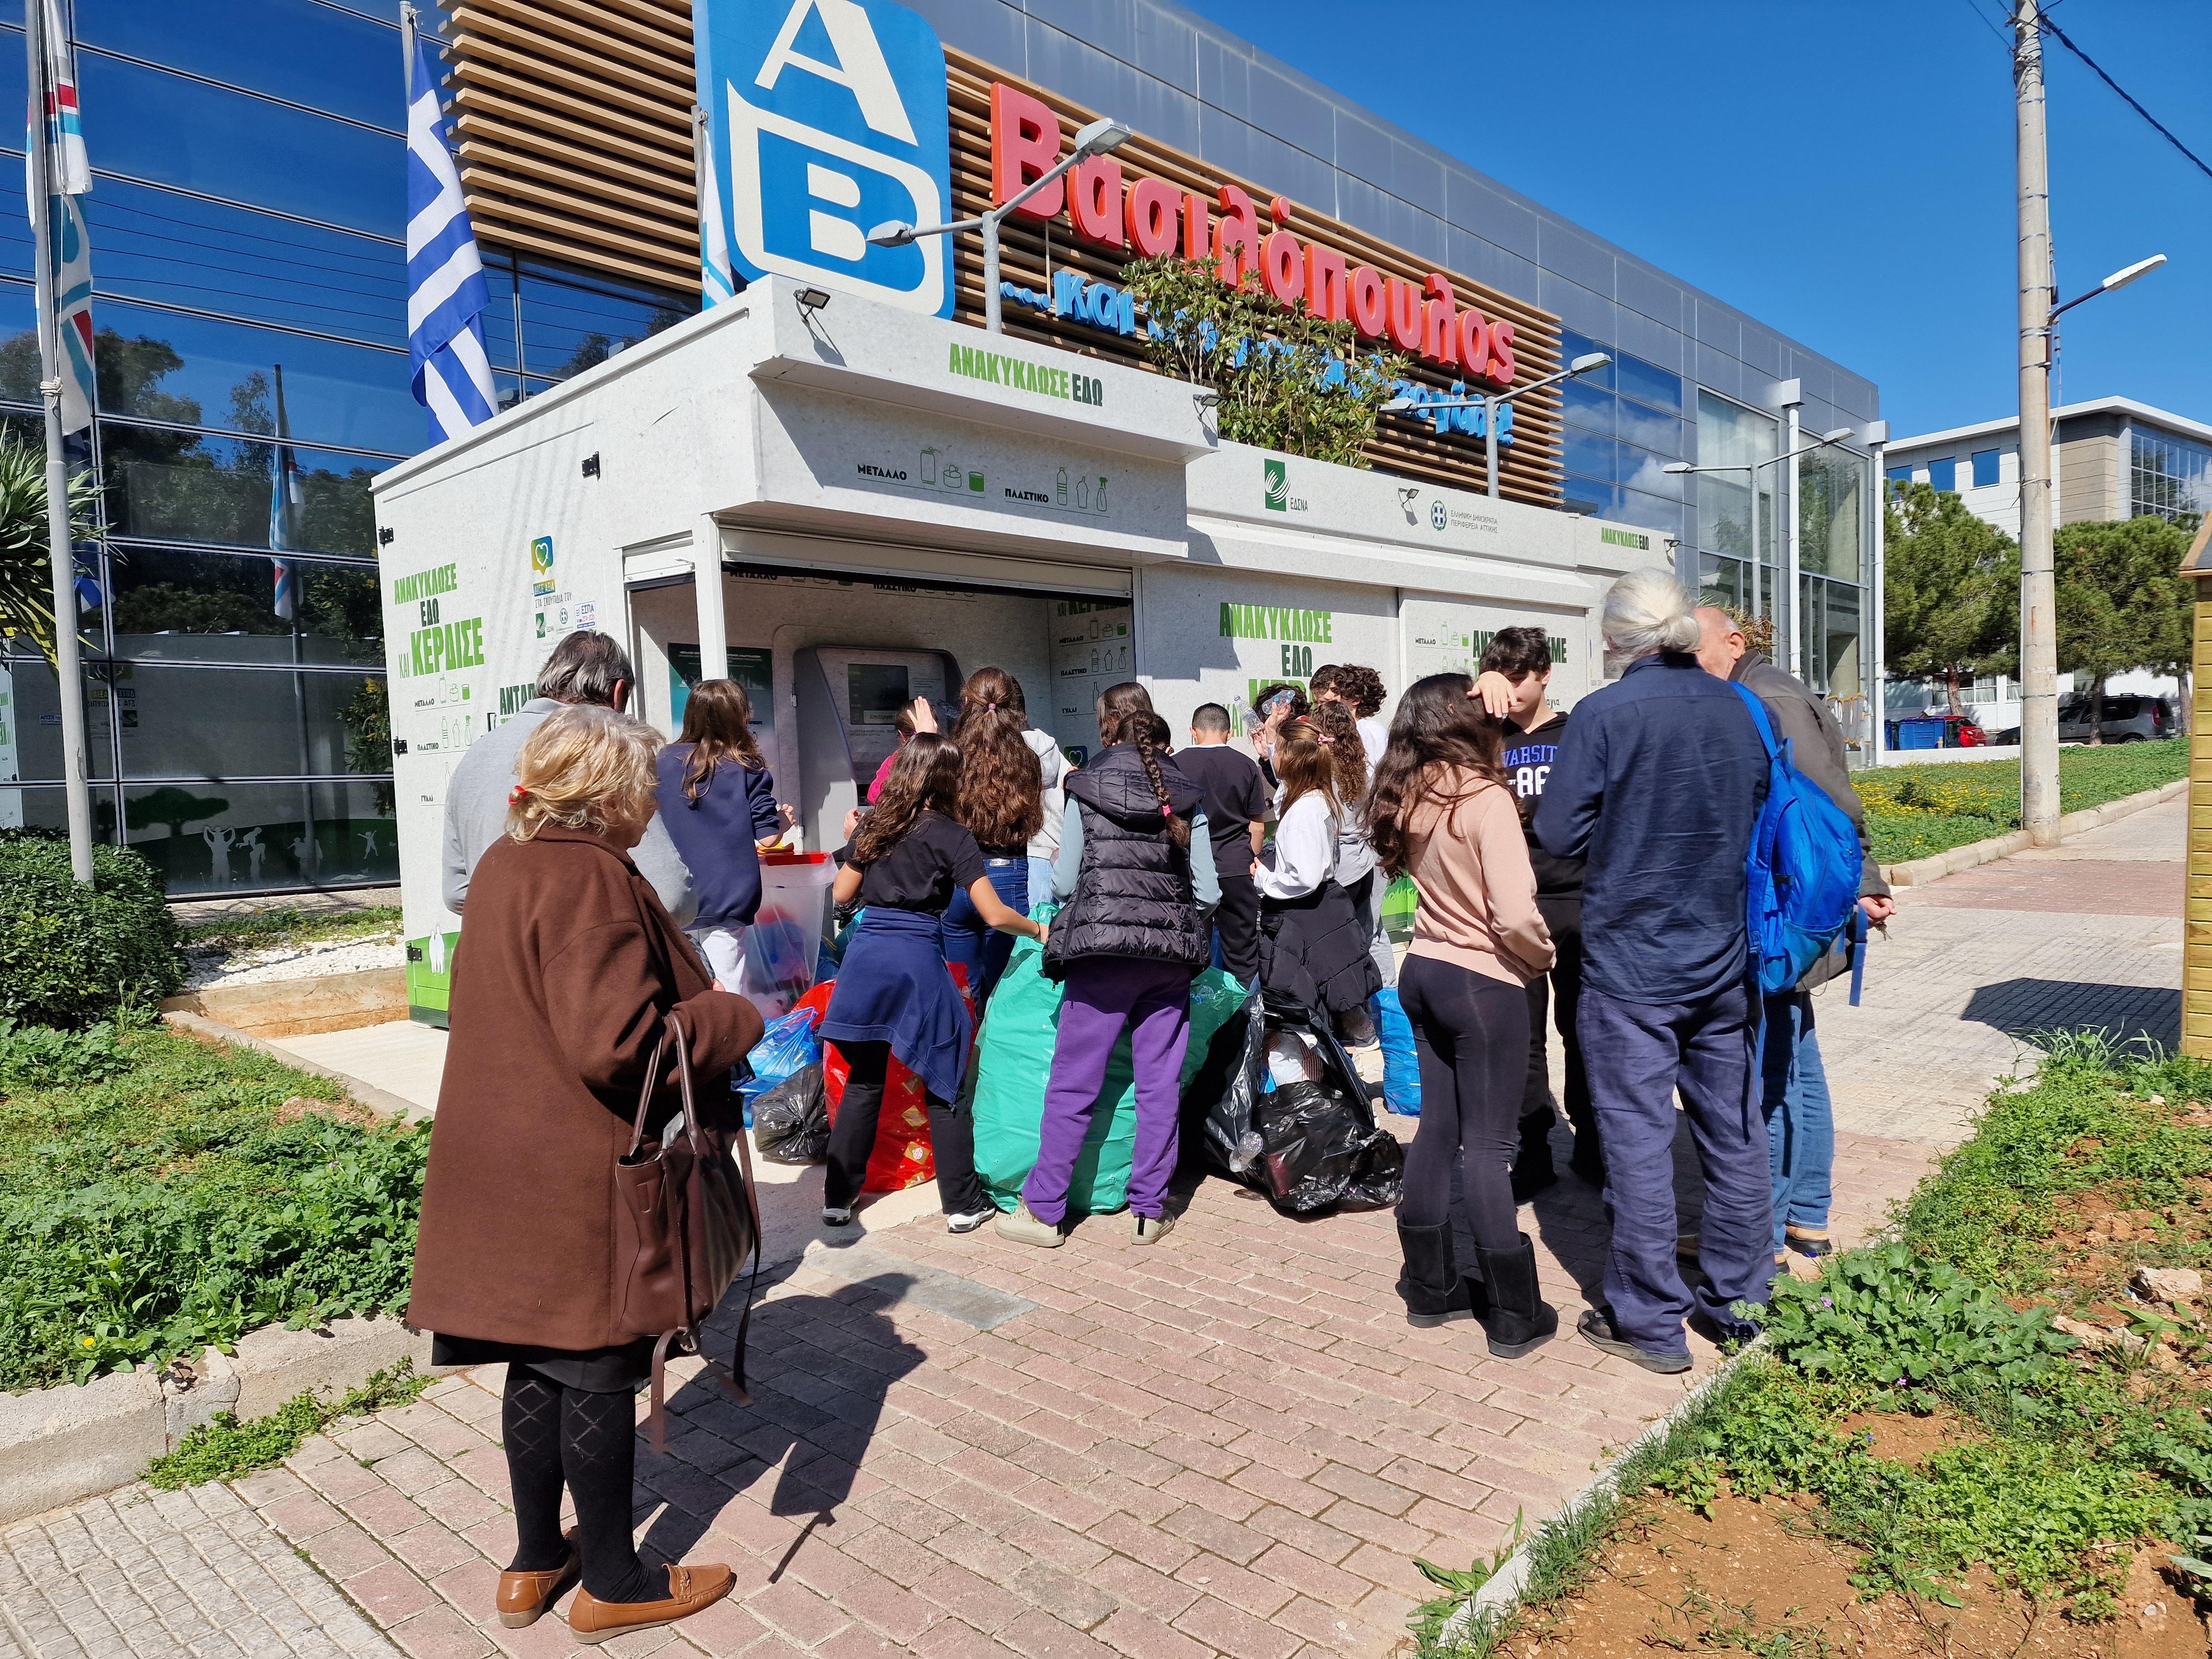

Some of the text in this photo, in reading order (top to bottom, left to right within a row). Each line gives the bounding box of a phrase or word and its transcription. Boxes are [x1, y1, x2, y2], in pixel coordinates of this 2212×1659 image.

[990, 81, 1515, 385] Βασιλόπουλος
[949, 342, 1103, 407] ΑΝΑΚΥΚΛΩΣΕ ΕΔΩ
[857, 463, 907, 481] ΜΕΤΑΛΛΟ
[1005, 488, 1049, 503] ΠΛΑΣΤΙΚΟ
[1290, 497, 1309, 513] ΕΔΣΝΑ
[1451, 519, 1498, 534] ΠΕΡΙΦΕΡΕΙΑ ΑΤΤΙΚΗΣ
[1601, 527, 1650, 551] ΑΝΑΚΥΚΛΩΣΕ ΕΔΩ
[394, 562, 457, 606] ΑΝΑΚΥΚΛΩΣΕ
[420, 598, 440, 627] ΕΔΩ
[581, 603, 594, 614] ΕΣΠΑ
[1220, 602, 1332, 644] ΑΝΑΚΥΚΛΩΣΕ
[399, 617, 484, 679] ΚΑΙ ΚΕΡΔΙΣΕ
[1415, 637, 1436, 645] ΜΕΤΑΛΛΟ
[1281, 644, 1313, 677] ΕΔΩ
